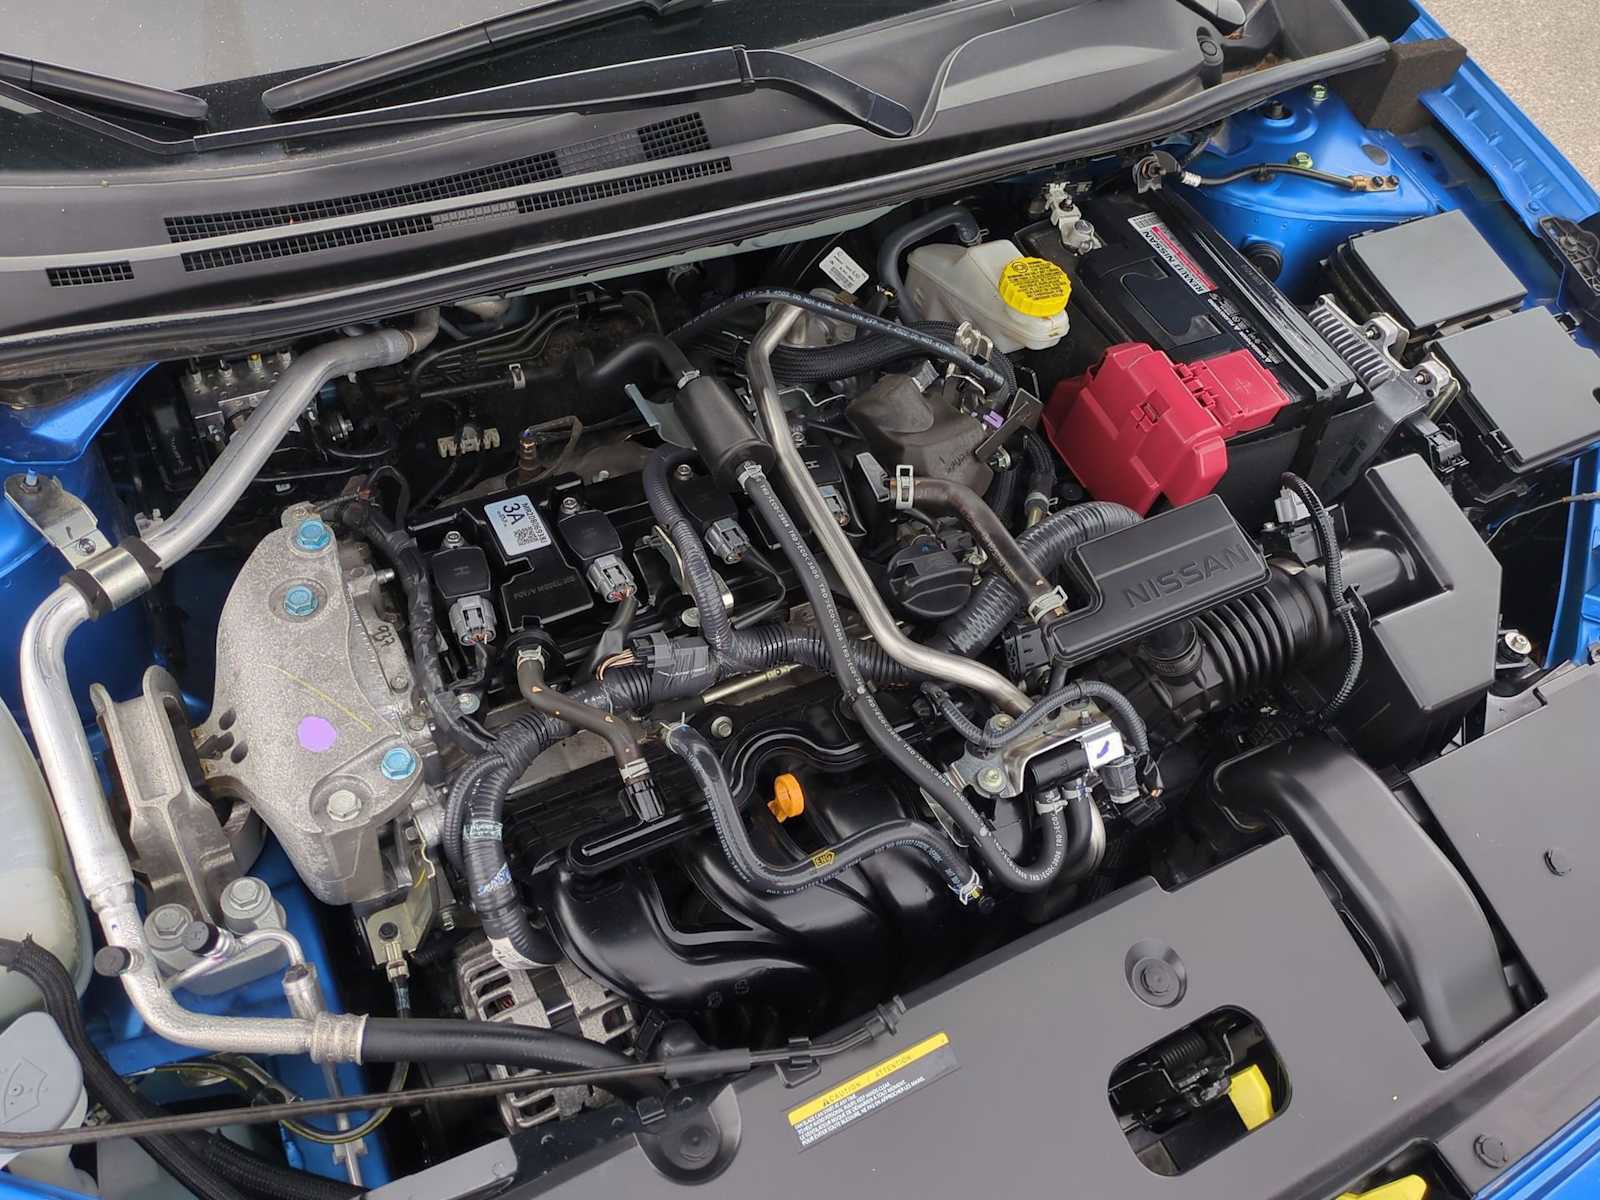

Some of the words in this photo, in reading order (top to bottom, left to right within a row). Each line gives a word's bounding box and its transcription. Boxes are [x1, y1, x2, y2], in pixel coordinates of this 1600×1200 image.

[1142, 231, 1174, 262] NISSAN
[503, 502, 525, 525] 3A
[1123, 544, 1250, 608] NISSAN
[829, 1082, 862, 1101] CAUTION
[876, 1055, 912, 1078] ATTENTION
